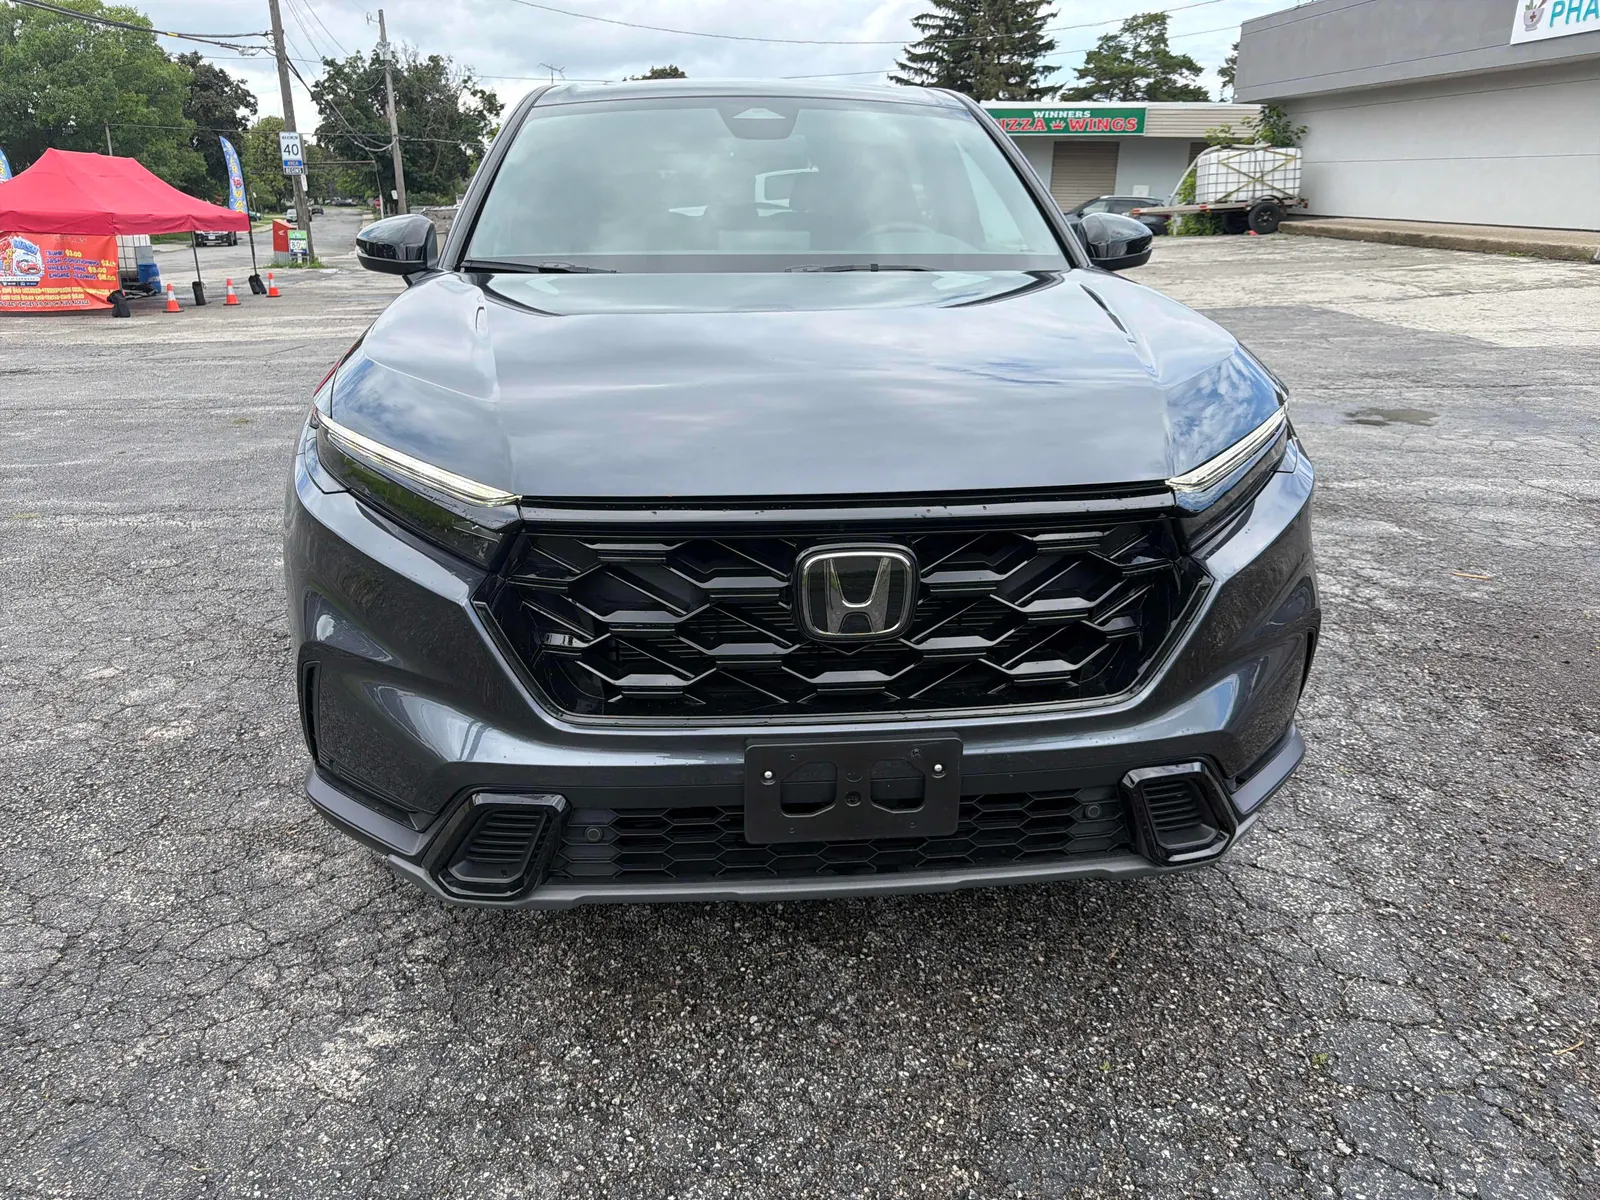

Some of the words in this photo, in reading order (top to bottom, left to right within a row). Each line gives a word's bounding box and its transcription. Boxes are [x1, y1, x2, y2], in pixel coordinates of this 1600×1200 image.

[1033, 110, 1091, 118] WINNERS
[996, 117, 1047, 131] IZZA
[1068, 117, 1137, 131] WINGS
[283, 143, 299, 156] 40
[13, 238, 39, 256] WASH
